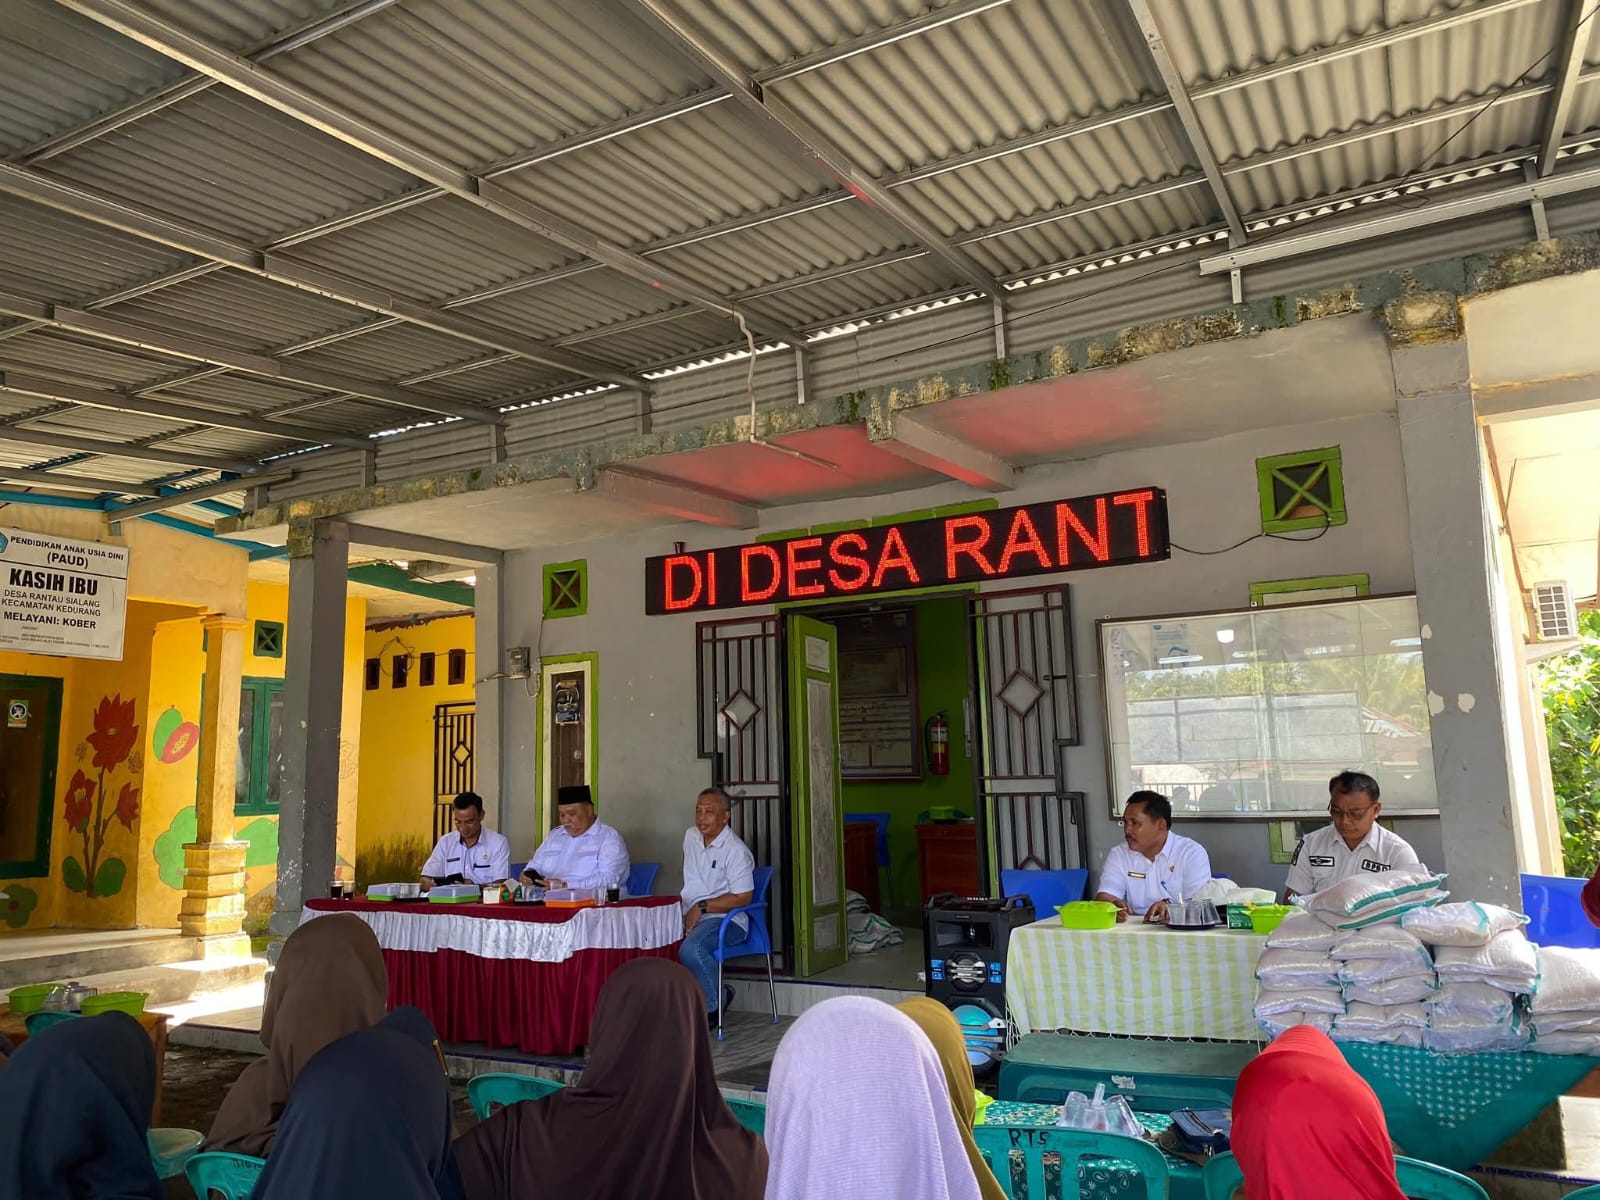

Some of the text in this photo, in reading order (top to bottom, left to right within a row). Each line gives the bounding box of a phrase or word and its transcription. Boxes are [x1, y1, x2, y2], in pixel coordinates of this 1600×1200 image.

[10, 536, 124, 560] PENDIDIKAN ANAK USIA DINI
[664, 491, 1153, 610] DI DESA RANT
[47, 552, 89, 569] (PAUD)
[9, 568, 98, 596] KASIH IBU
[1, 598, 101, 616] KECAMATAN KEDURANG
[4, 589, 100, 608] DESA RANTAU SIALANG
[3, 611, 96, 629] MELAYANI: KOBER
